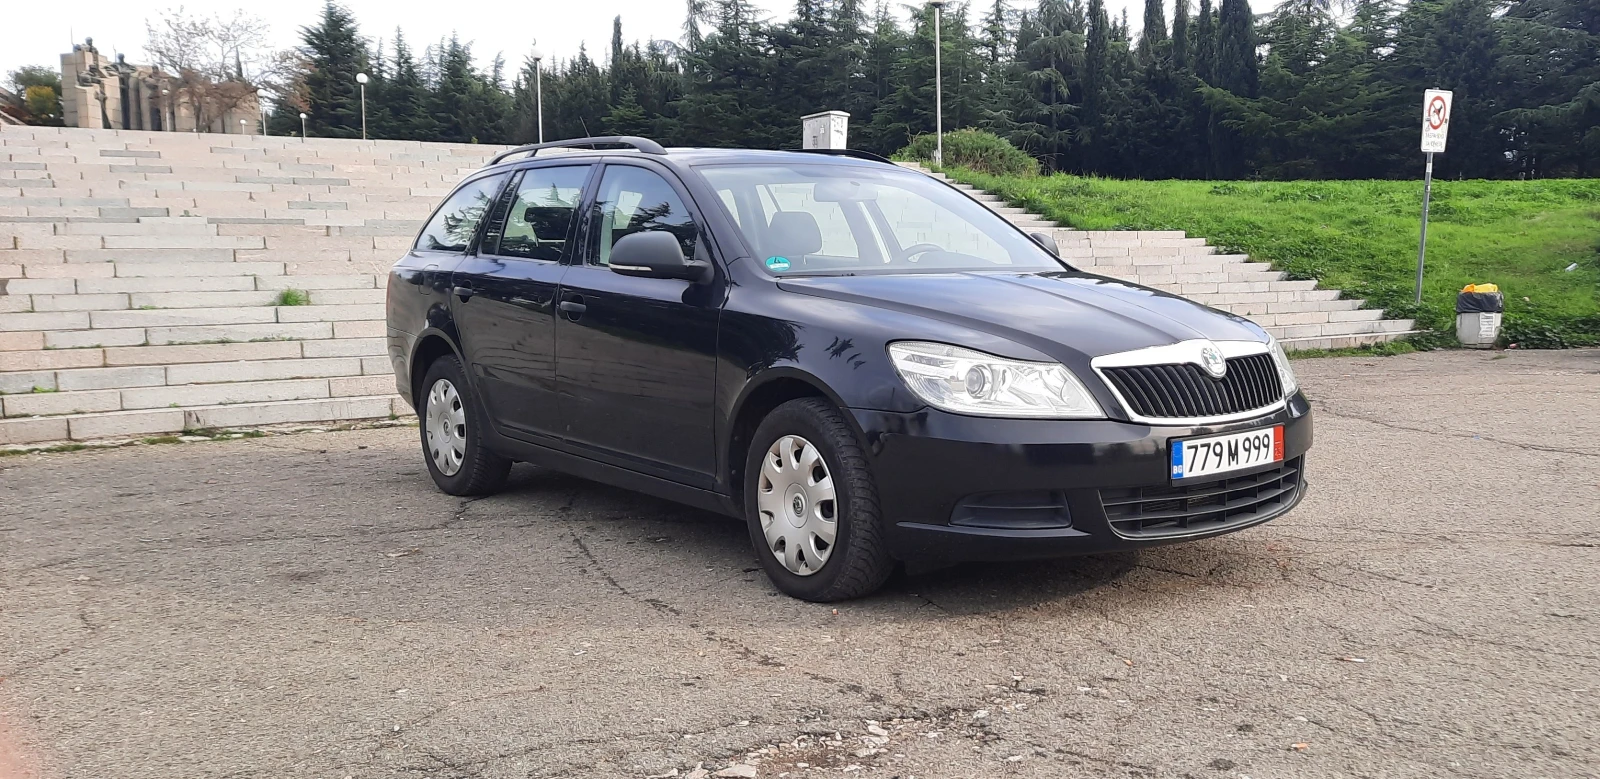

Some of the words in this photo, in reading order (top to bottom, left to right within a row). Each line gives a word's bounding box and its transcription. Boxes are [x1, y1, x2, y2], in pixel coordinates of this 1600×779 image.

[1187, 441, 1224, 473] 779
[1227, 438, 1239, 467] M
[1242, 433, 1270, 463] 999
[1173, 465, 1183, 474] BG
